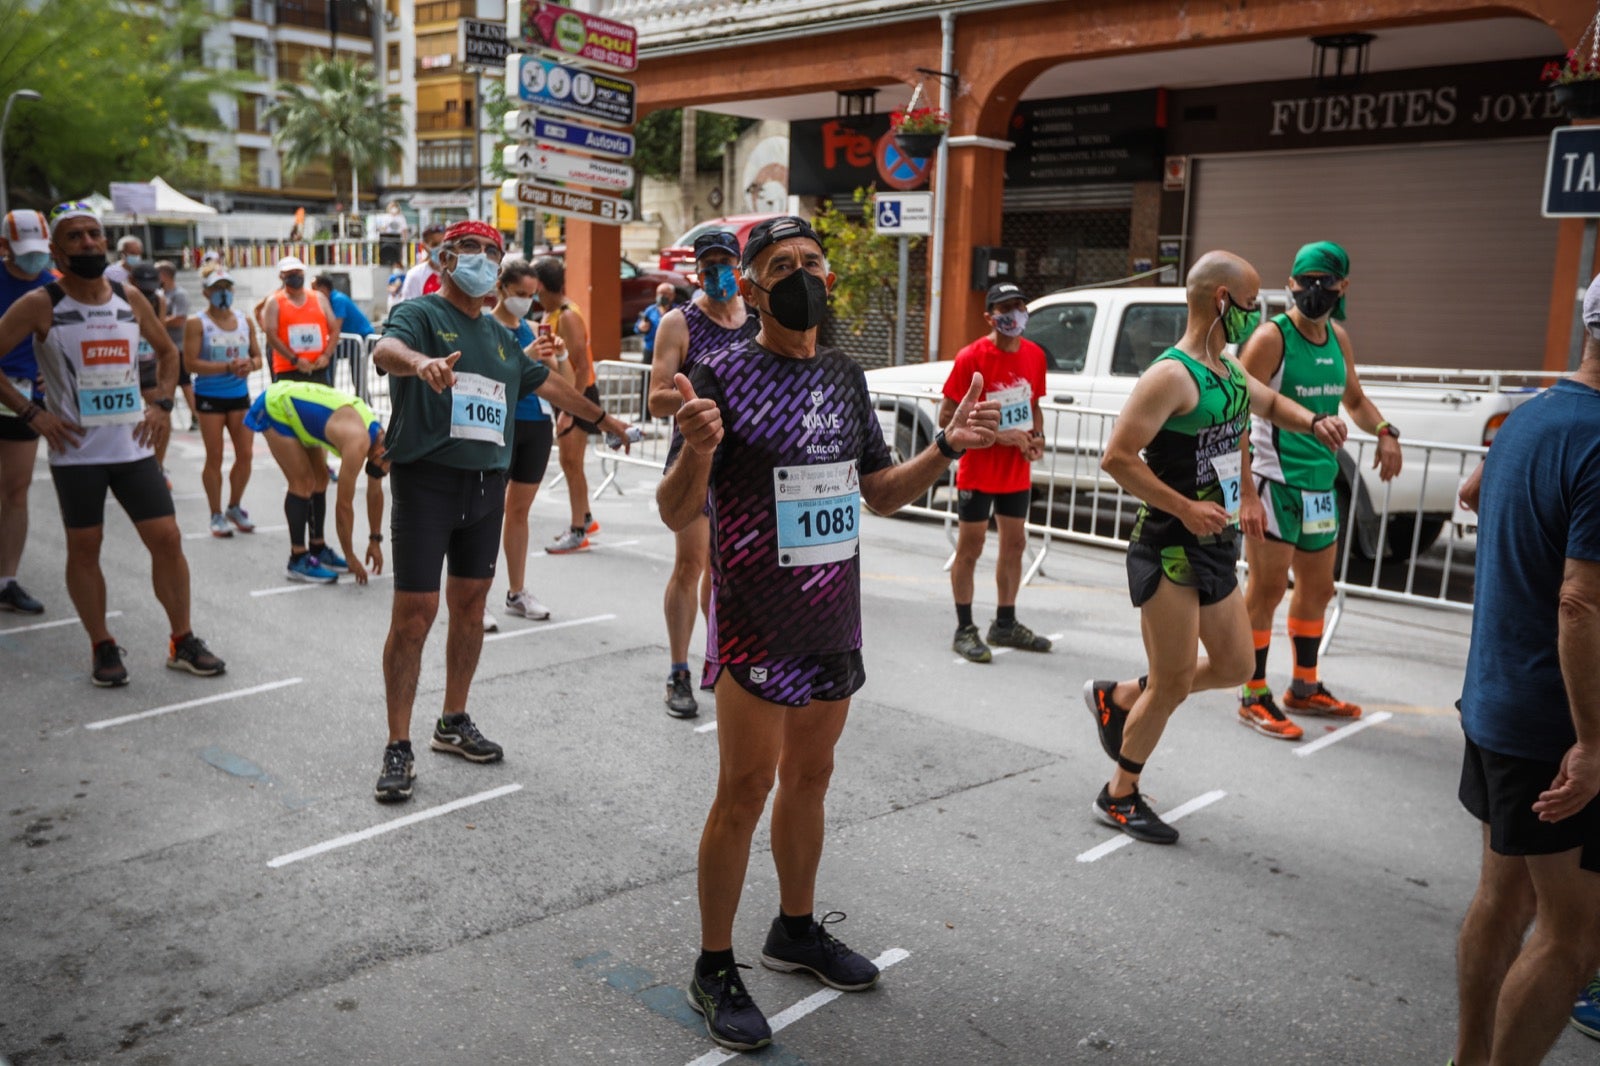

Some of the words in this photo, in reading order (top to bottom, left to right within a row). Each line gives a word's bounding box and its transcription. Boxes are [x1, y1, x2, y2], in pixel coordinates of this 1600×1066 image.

[467, 21, 505, 41] CLINI
[1269, 86, 1458, 136] FUERTES
[1472, 91, 1566, 123] JOYE
[822, 121, 877, 170] Fe
[1562, 152, 1600, 193] TA
[86, 344, 127, 358] STIHL
[91, 391, 135, 411] 1075
[1296, 385, 1322, 397] Team
[465, 402, 501, 426] 1065
[803, 413, 840, 429] WAVE
[1230, 480, 1240, 503] 2
[1314, 495, 1332, 514] 145
[797, 505, 855, 538] 1083
